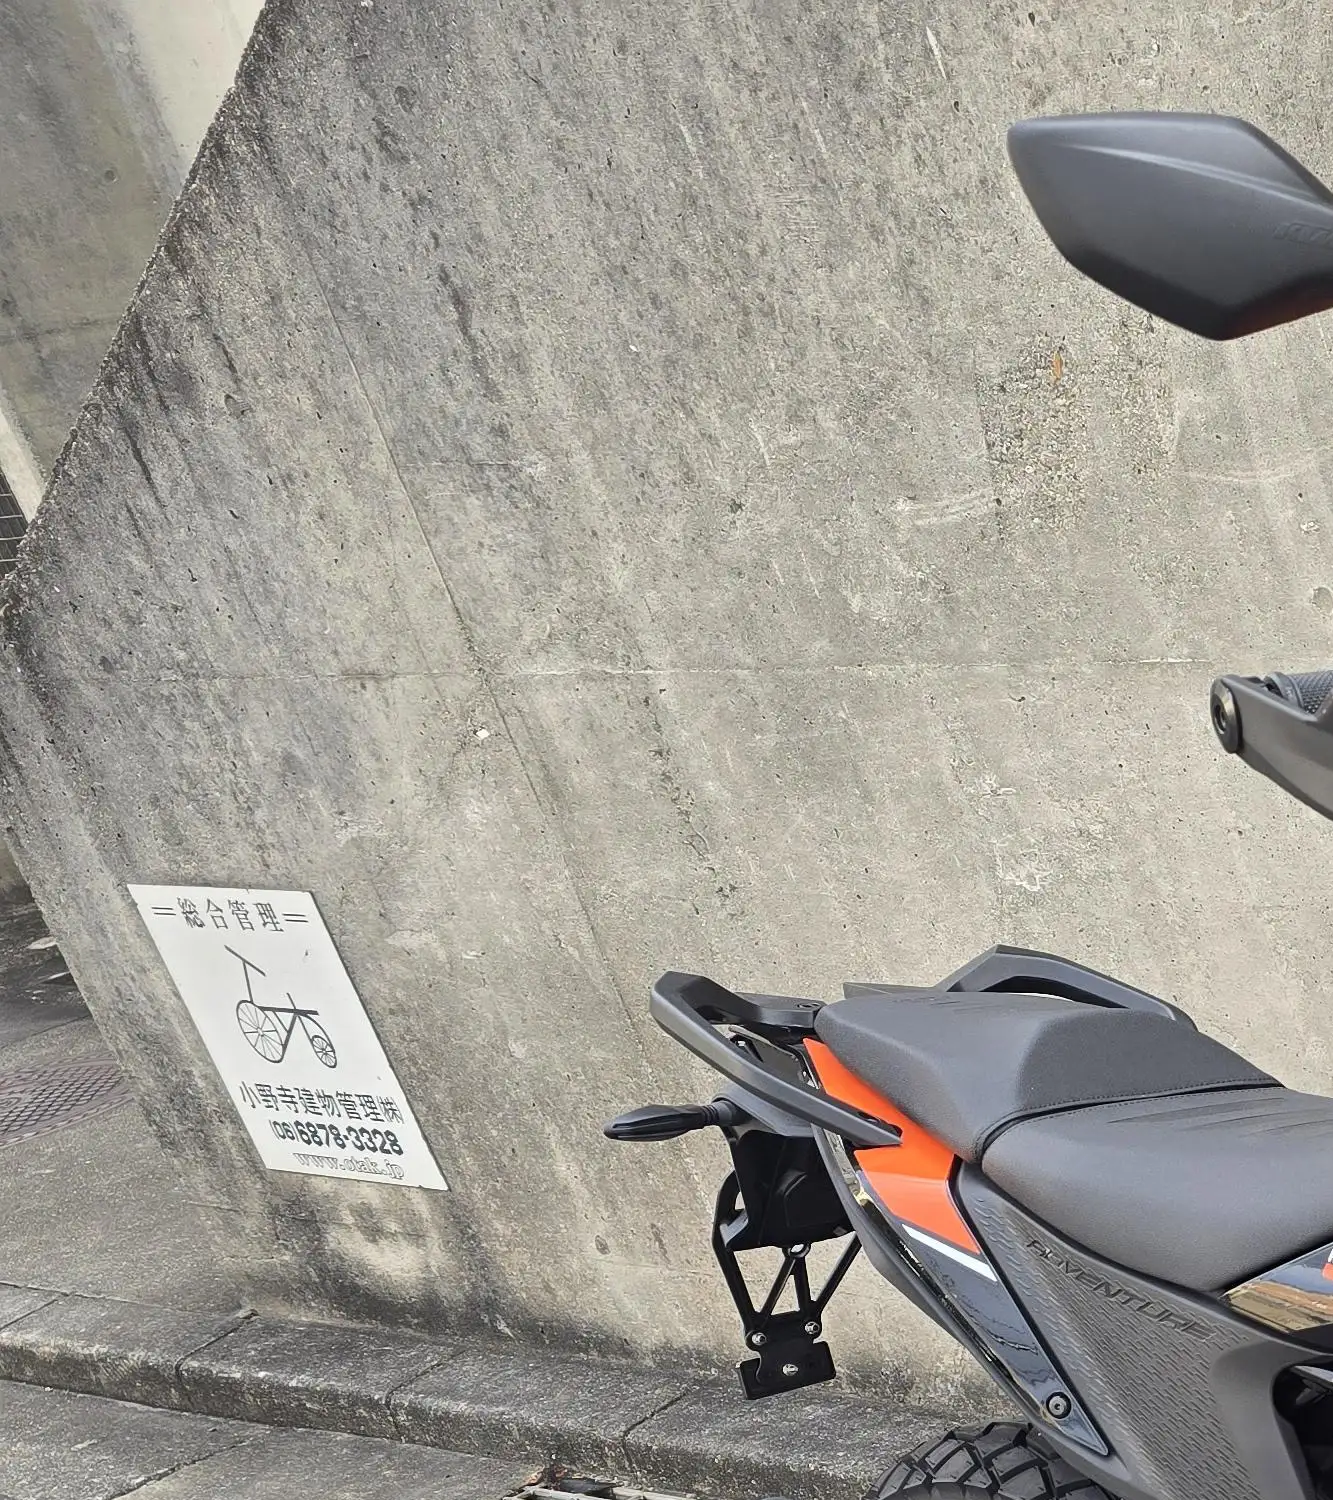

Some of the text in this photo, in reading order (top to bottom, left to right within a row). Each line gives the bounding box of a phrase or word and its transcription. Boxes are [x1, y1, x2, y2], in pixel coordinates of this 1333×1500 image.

[177, 897, 284, 932] 総合管理
[292, 1152, 404, 1180] www.otak.jp
[1026, 1239, 1217, 1342] ADVENTURE
